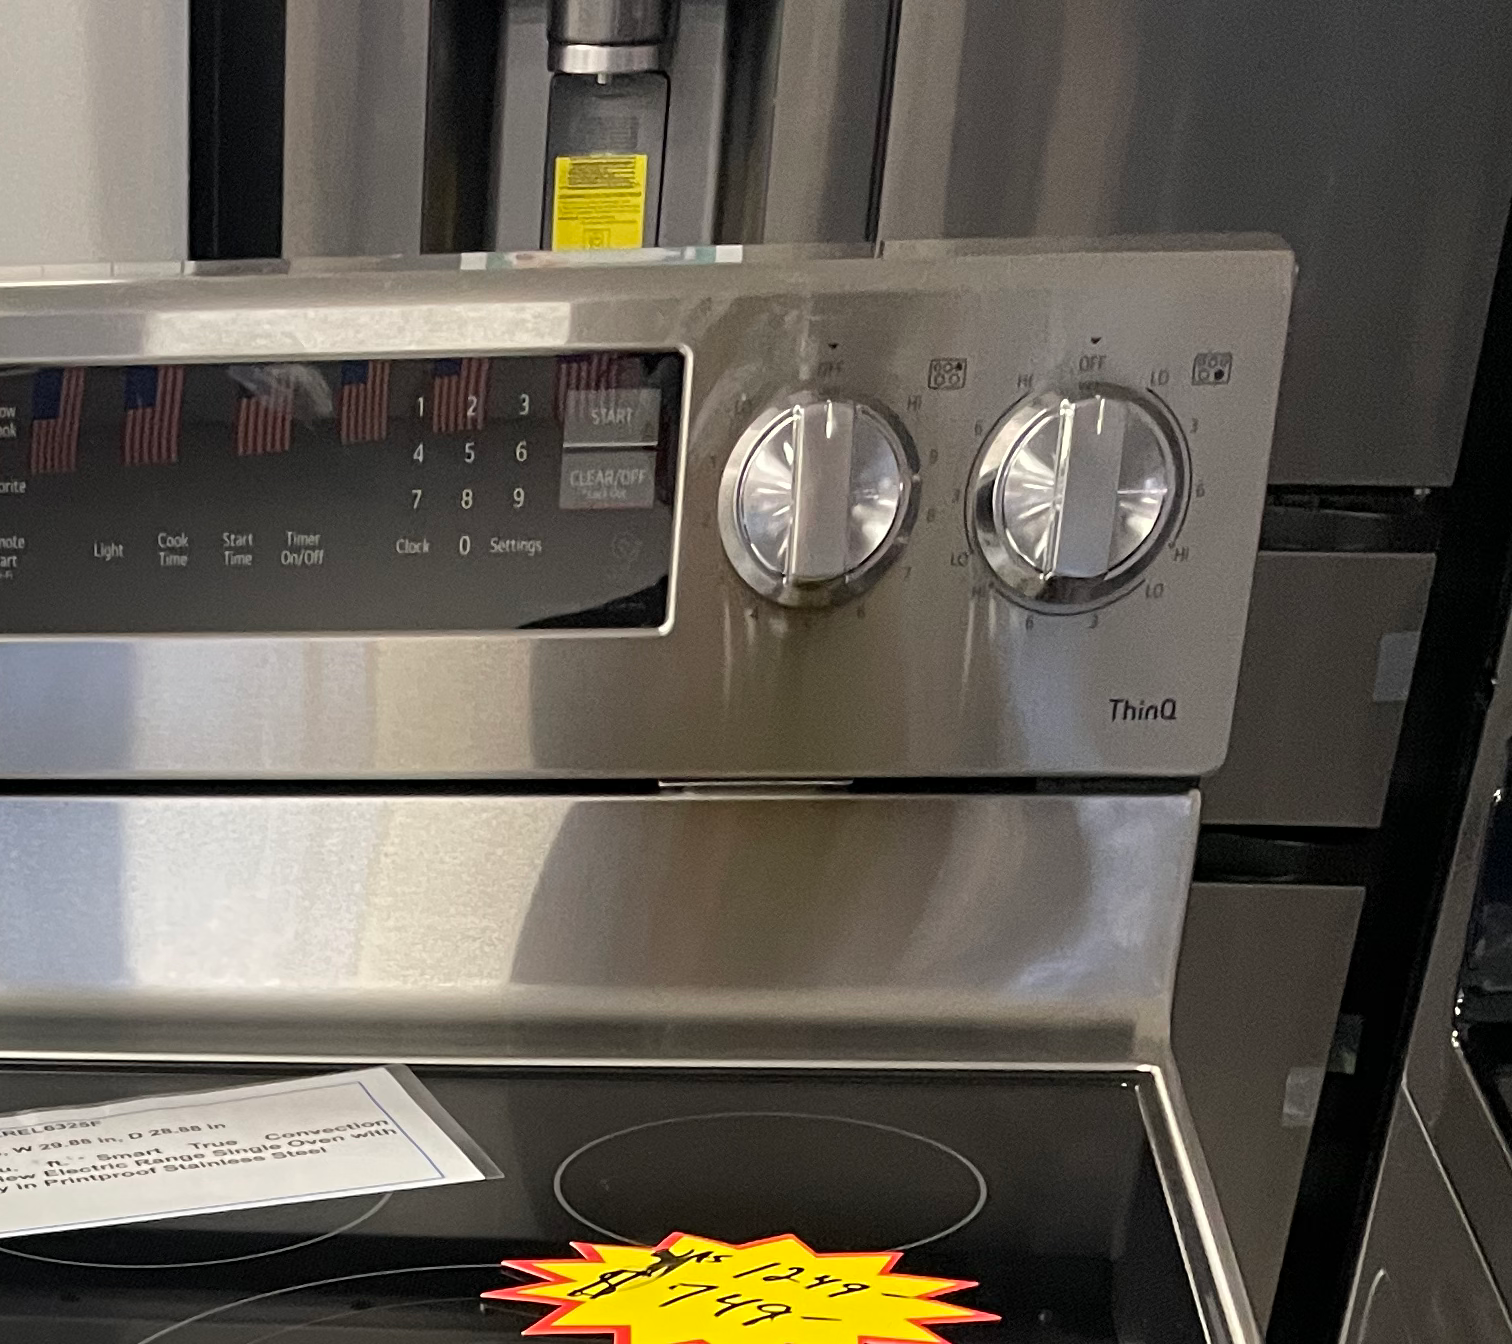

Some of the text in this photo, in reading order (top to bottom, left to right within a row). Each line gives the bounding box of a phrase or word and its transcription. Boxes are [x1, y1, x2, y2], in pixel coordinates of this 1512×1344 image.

[1079, 355, 1107, 373] OFF
[1150, 368, 1170, 386] LO
[418, 396, 424, 417] 1
[466, 395, 478, 417] 2
[519, 393, 530, 416] 3
[591, 407, 634, 425] START
[413, 443, 424, 463] 4
[464, 441, 476, 464] 5
[515, 440, 528, 462] 6
[411, 489, 422, 510] 7
[461, 488, 473, 509] 8
[513, 487, 525, 508] 9
[157, 532, 188, 548] Cook
[223, 532, 253, 547] Start
[286, 530, 321, 546] Timer
[395, 537, 430, 554] Clock
[459, 535, 471, 555] 0
[489, 536, 543, 557] Settings
[93, 541, 124, 561] Light
[158, 551, 188, 566] Time
[224, 551, 252, 566] Time
[280, 550, 324, 566] On/Off
[1145, 582, 1164, 598] LO
[1109, 698, 1177, 722] ThinQ
[12, 1144, 33, 1154] W
[128, 1131, 144, 1141] D
[205, 1121, 226, 1131] in
[96, 1147, 164, 1162] Smart
[188, 1139, 238, 1150] True
[264, 1119, 389, 1141] Convection
[43, 1161, 129, 1178] Electric
[134, 1152, 206, 1168] Range
[212, 1142, 283, 1157] Single
[287, 1135, 346, 1148] Oven
[349, 1126, 398, 1140] with
[16, 1181, 38, 1191] in
[43, 1165, 158, 1188] Printproof
[162, 1155, 267, 1173] Stainless
[271, 1146, 329, 1161] Steel
